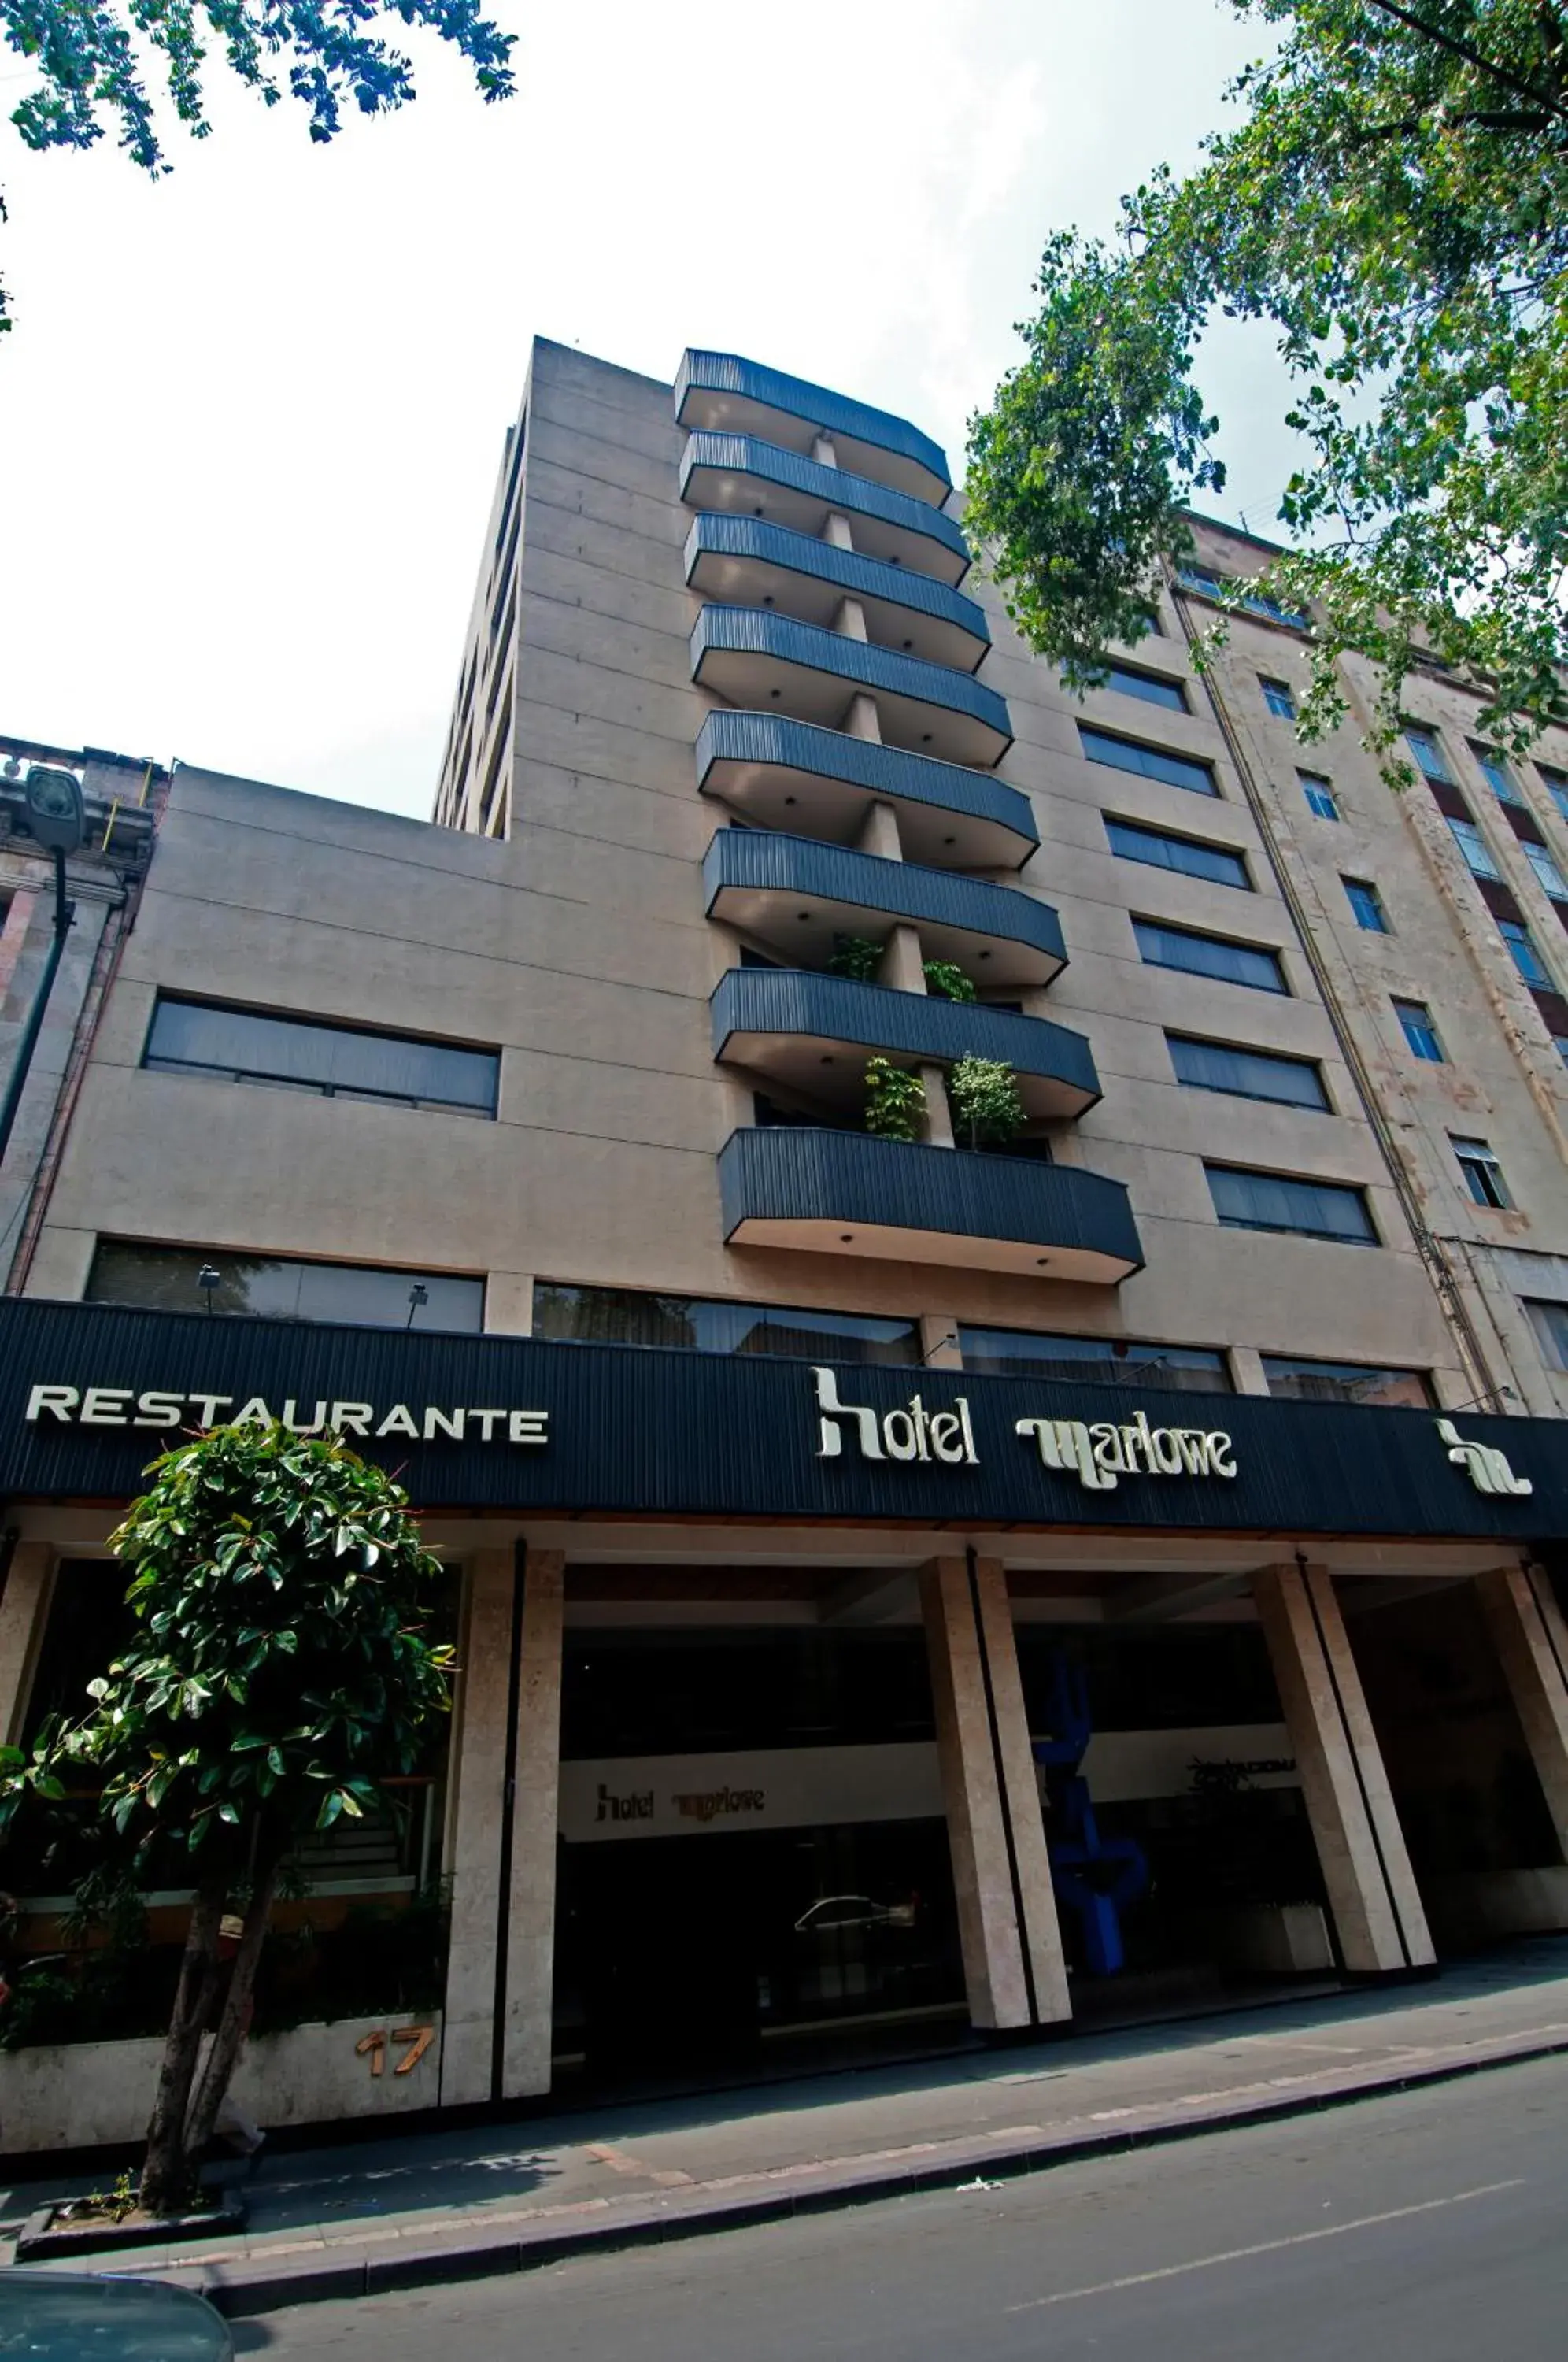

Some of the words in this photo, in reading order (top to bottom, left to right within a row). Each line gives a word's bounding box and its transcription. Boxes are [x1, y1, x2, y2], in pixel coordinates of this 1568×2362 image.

[25, 1384, 549, 1443] RESTAURANTE
[809, 1367, 981, 1464] hotel
[1015, 1410, 1237, 1490] marlowe
[596, 1783, 654, 1821] hotel
[356, 2026, 435, 2075] 17
